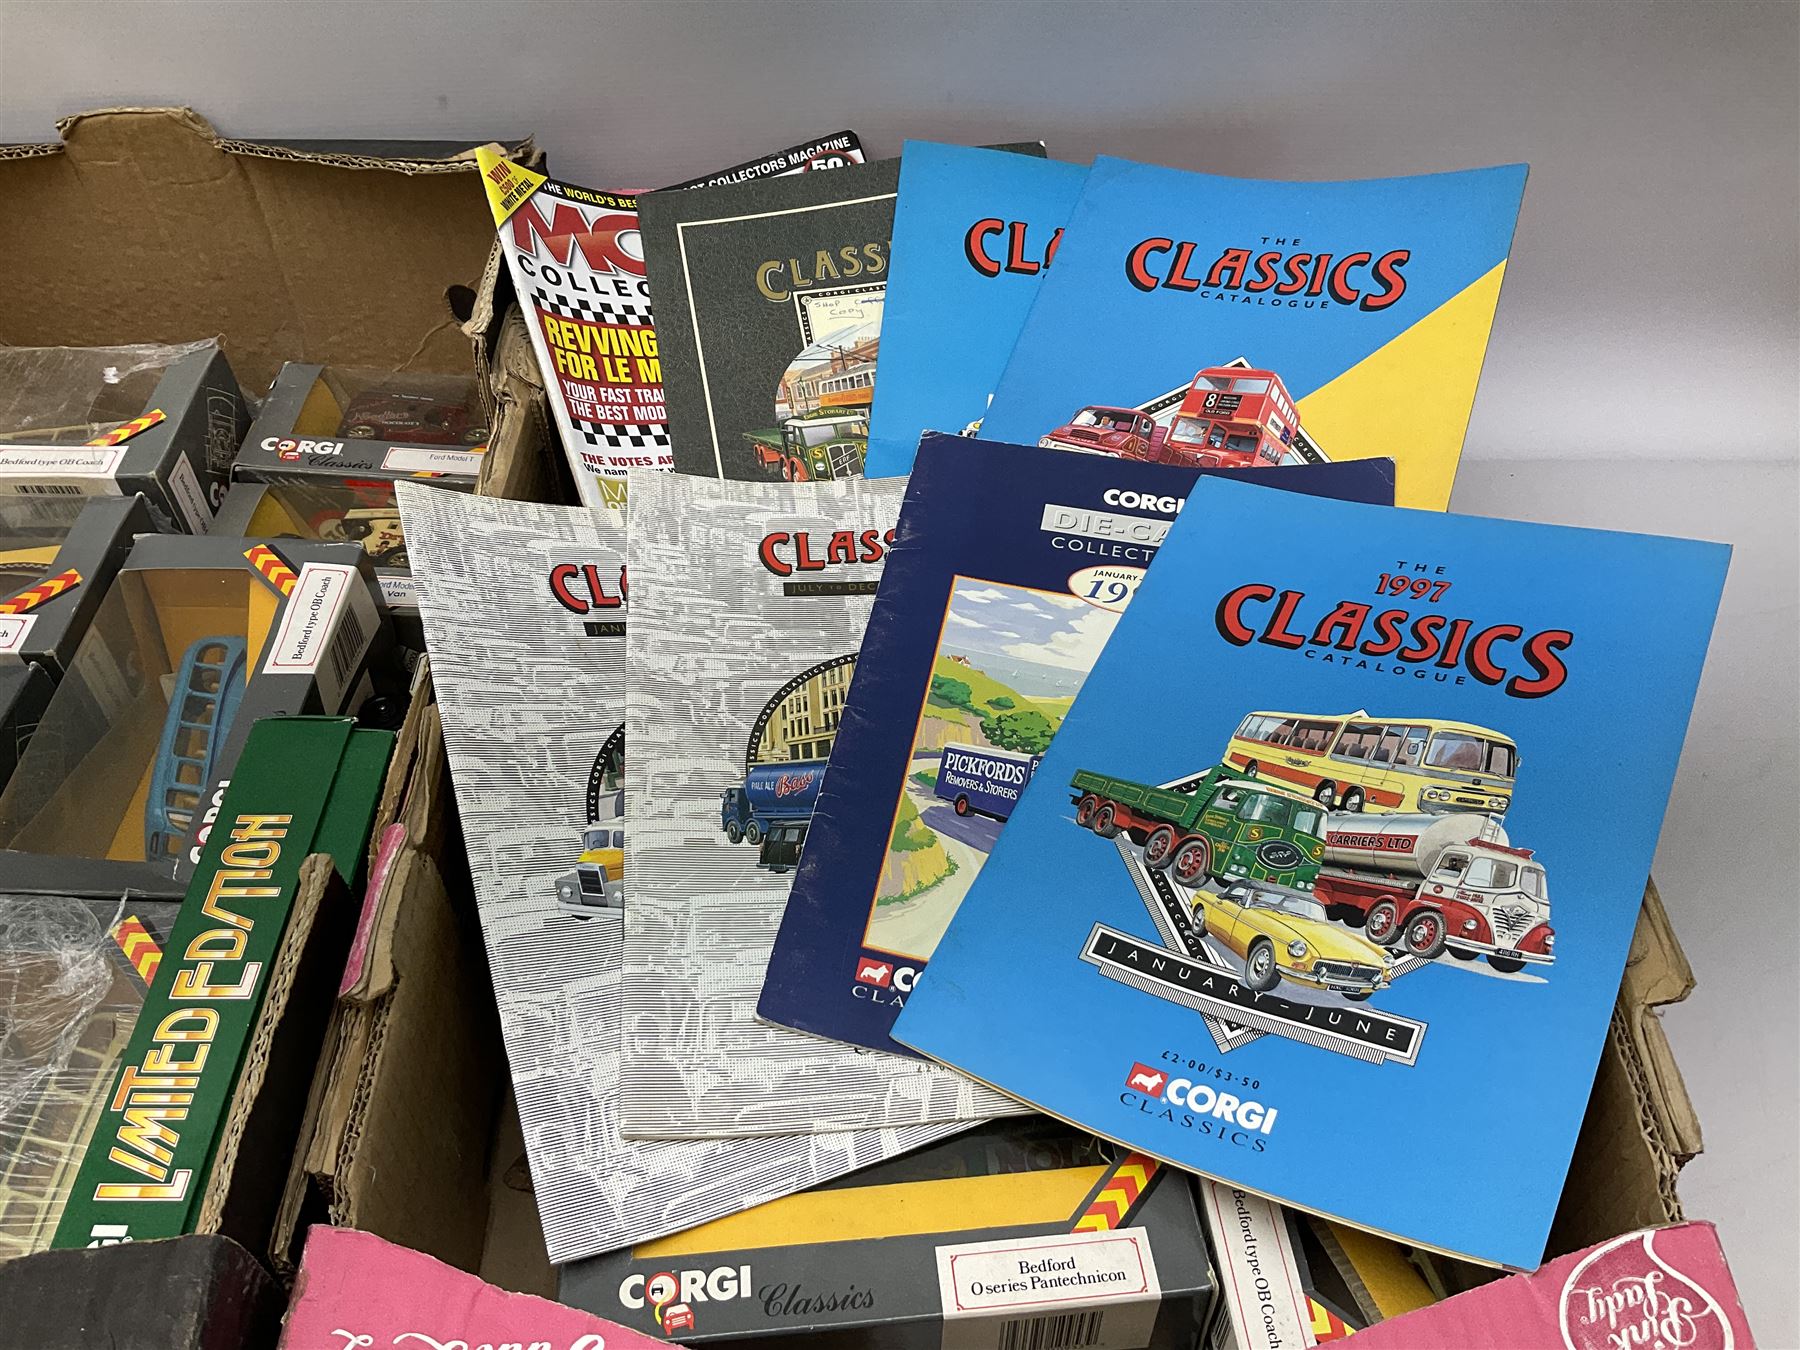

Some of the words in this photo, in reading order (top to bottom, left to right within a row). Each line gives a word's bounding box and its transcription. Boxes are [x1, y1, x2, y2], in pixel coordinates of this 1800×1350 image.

[789, 136, 851, 164] MAGAZINE
[487, 161, 512, 185] WIN
[500, 190, 519, 211] WHITE
[516, 177, 535, 198] METAL
[564, 187, 616, 207] WORLD'S
[1260, 236, 1302, 247] THE
[755, 240, 892, 303] CLASS
[1125, 236, 1411, 313] CLASSICS
[817, 289, 851, 297] CORGI
[1200, 290, 1330, 311] CATALOGUE
[543, 314, 659, 357] REVVING
[554, 347, 600, 382] FOR
[602, 356, 634, 384] LE
[563, 379, 598, 402] YOUR
[600, 387, 632, 404] FAST
[634, 388, 666, 403] TRA
[1150, 394, 1183, 411] CORGI
[1205, 393, 1217, 408] 8
[569, 400, 594, 419] THE
[596, 404, 630, 422] BEST
[260, 436, 346, 457] CORGI
[429, 453, 446, 461] Ford
[0, 458, 38, 466] Bedford
[38, 458, 58, 467] type
[75, 458, 104, 467] Coach
[307, 453, 374, 471] Classics
[580, 452, 607, 466] THE
[607, 455, 654, 468] VOTES
[583, 462, 602, 475] We
[1092, 569, 1139, 581] JANUARY
[1397, 559, 1448, 576] THE
[315, 576, 332, 598] Coach
[387, 590, 407, 598] Van
[791, 583, 825, 593] JULY
[1083, 579, 1138, 604] 19
[1373, 572, 1453, 603] 1997
[309, 598, 323, 611] OB
[307, 611, 319, 629] type
[291, 629, 313, 660] Bedford
[1214, 582, 1574, 699] CLASSICS
[1303, 648, 1467, 686] CATALOGUE
[759, 699, 779, 726] CORGI
[780, 665, 826, 696] CLASSICS
[944, 751, 1026, 785] PICKFORDS
[750, 780, 764, 790] PALE
[764, 780, 775, 791] ALE
[775, 770, 816, 799] Bass
[945, 770, 980, 792] REMOVERS
[978, 782, 985, 792] &
[983, 780, 1018, 800] STORERS
[1249, 827, 1260, 839] S
[1329, 833, 1384, 848] CARRIERS
[1106, 941, 1264, 1004] JANUARY
[1304, 1006, 1398, 1042] JUNE
[1166, 1078, 1278, 1135] CORGI
[1118, 1092, 1267, 1153] CLASSICS
[1232, 1188, 1258, 1243] Bedford
[1018, 1256, 1077, 1275] Bedford
[1245, 1243, 1263, 1276] type
[619, 1265, 751, 1309] CORGI
[970, 1281, 984, 1296] O
[985, 1279, 1028, 1295] series
[1030, 1270, 1127, 1291] Pantechnicon
[1253, 1277, 1273, 1302] OB
[758, 1283, 875, 1318] Classics
[1571, 1270, 1665, 1330] Lady
[1261, 1303, 1283, 1350] Coach
